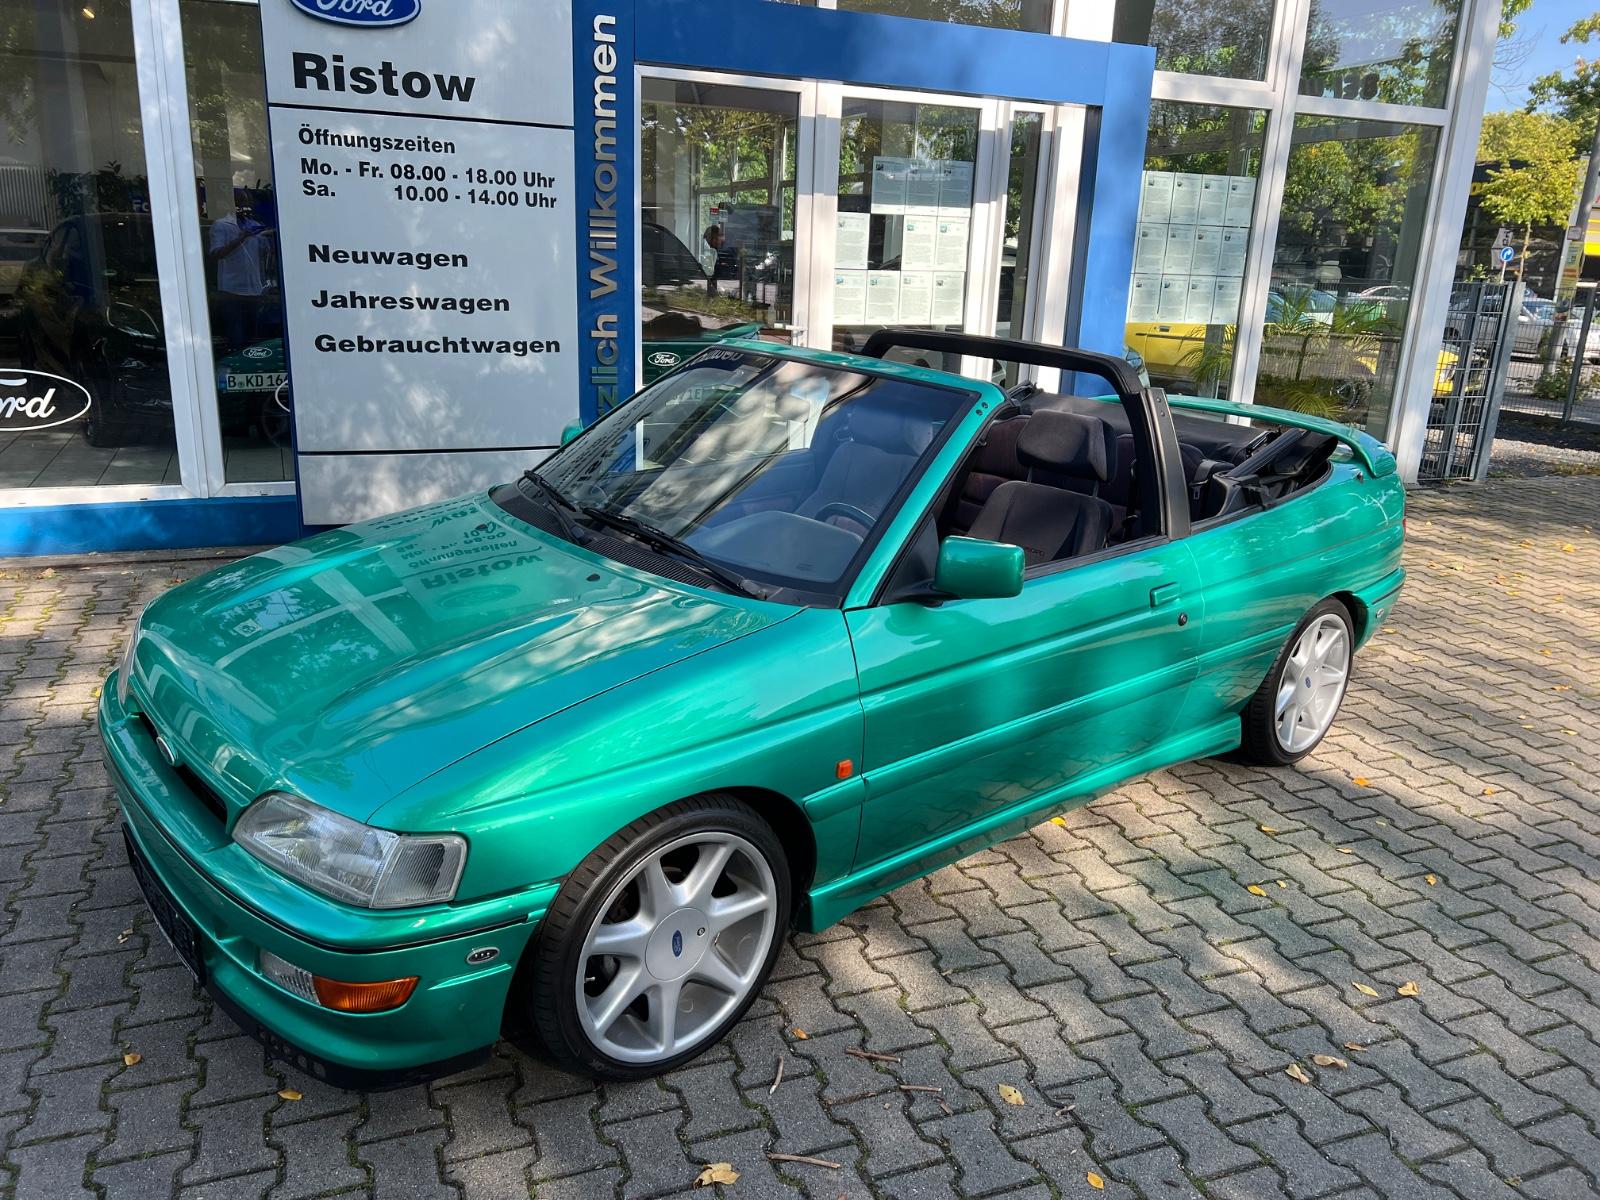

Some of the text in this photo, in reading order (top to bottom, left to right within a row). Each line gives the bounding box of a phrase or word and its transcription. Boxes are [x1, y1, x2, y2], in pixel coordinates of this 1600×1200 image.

[292, 52, 475, 102] Ristow
[298, 124, 456, 154] Öffnungszeiten
[301, 158, 338, 175] Mo.
[359, 161, 383, 178] Fr.
[391, 164, 446, 181] 08.00
[466, 168, 516, 186] 18.00
[523, 172, 555, 188] Uhr
[302, 179, 336, 196] Sa.
[394, 185, 448, 202] 10.00
[468, 189, 518, 206] 14.00
[525, 192, 557, 208] Uhr
[589, 14, 618, 416] zlich Willkommen
[308, 244, 468, 270] Neuwagen
[311, 290, 510, 315] Jahreswagen
[314, 334, 561, 357] Gebrauchtwagen
[227, 375, 237, 388] B
[245, 374, 264, 387] KD
